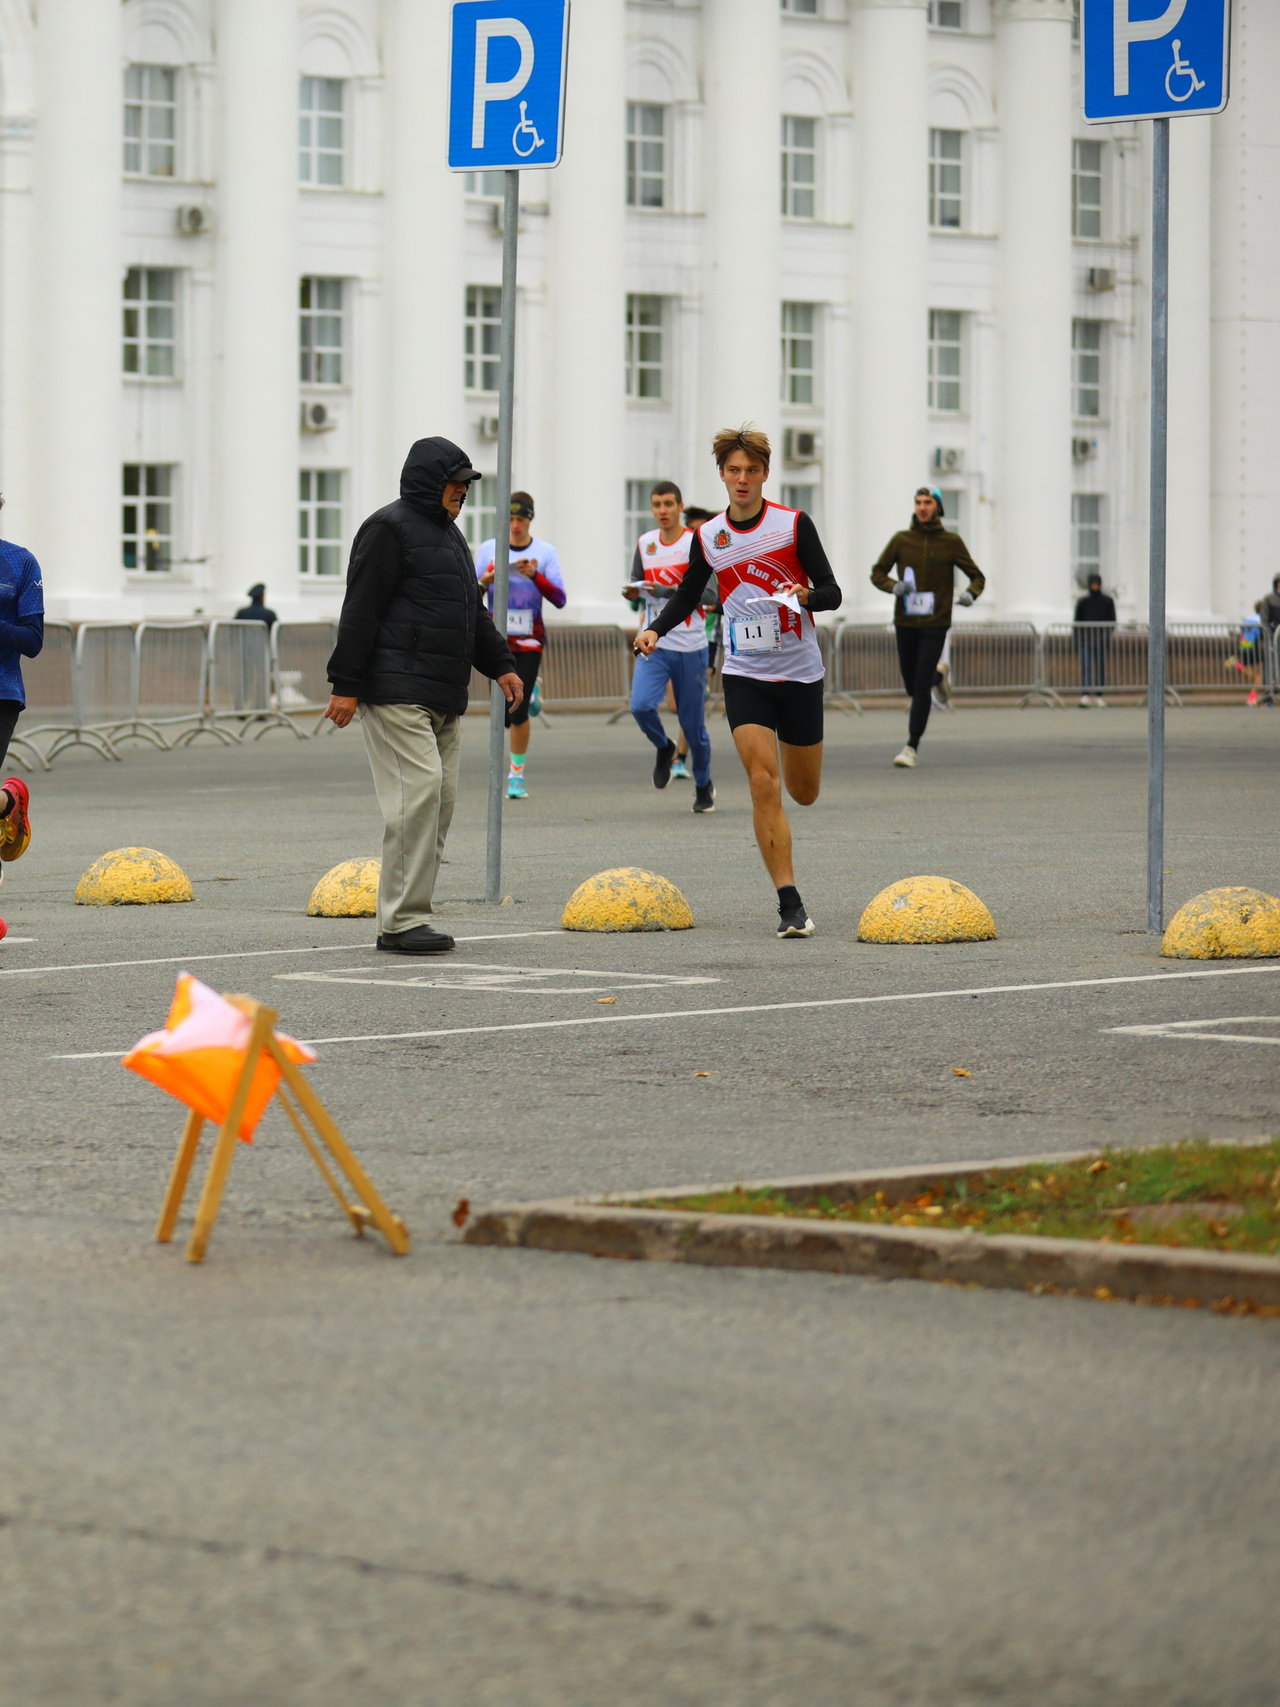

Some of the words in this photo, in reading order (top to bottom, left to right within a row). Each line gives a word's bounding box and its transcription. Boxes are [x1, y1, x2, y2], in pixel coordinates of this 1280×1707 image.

[1113, 0, 1188, 97] P
[471, 17, 535, 149] P
[746, 564, 770, 581] Run
[744, 625, 763, 639] 1.1
